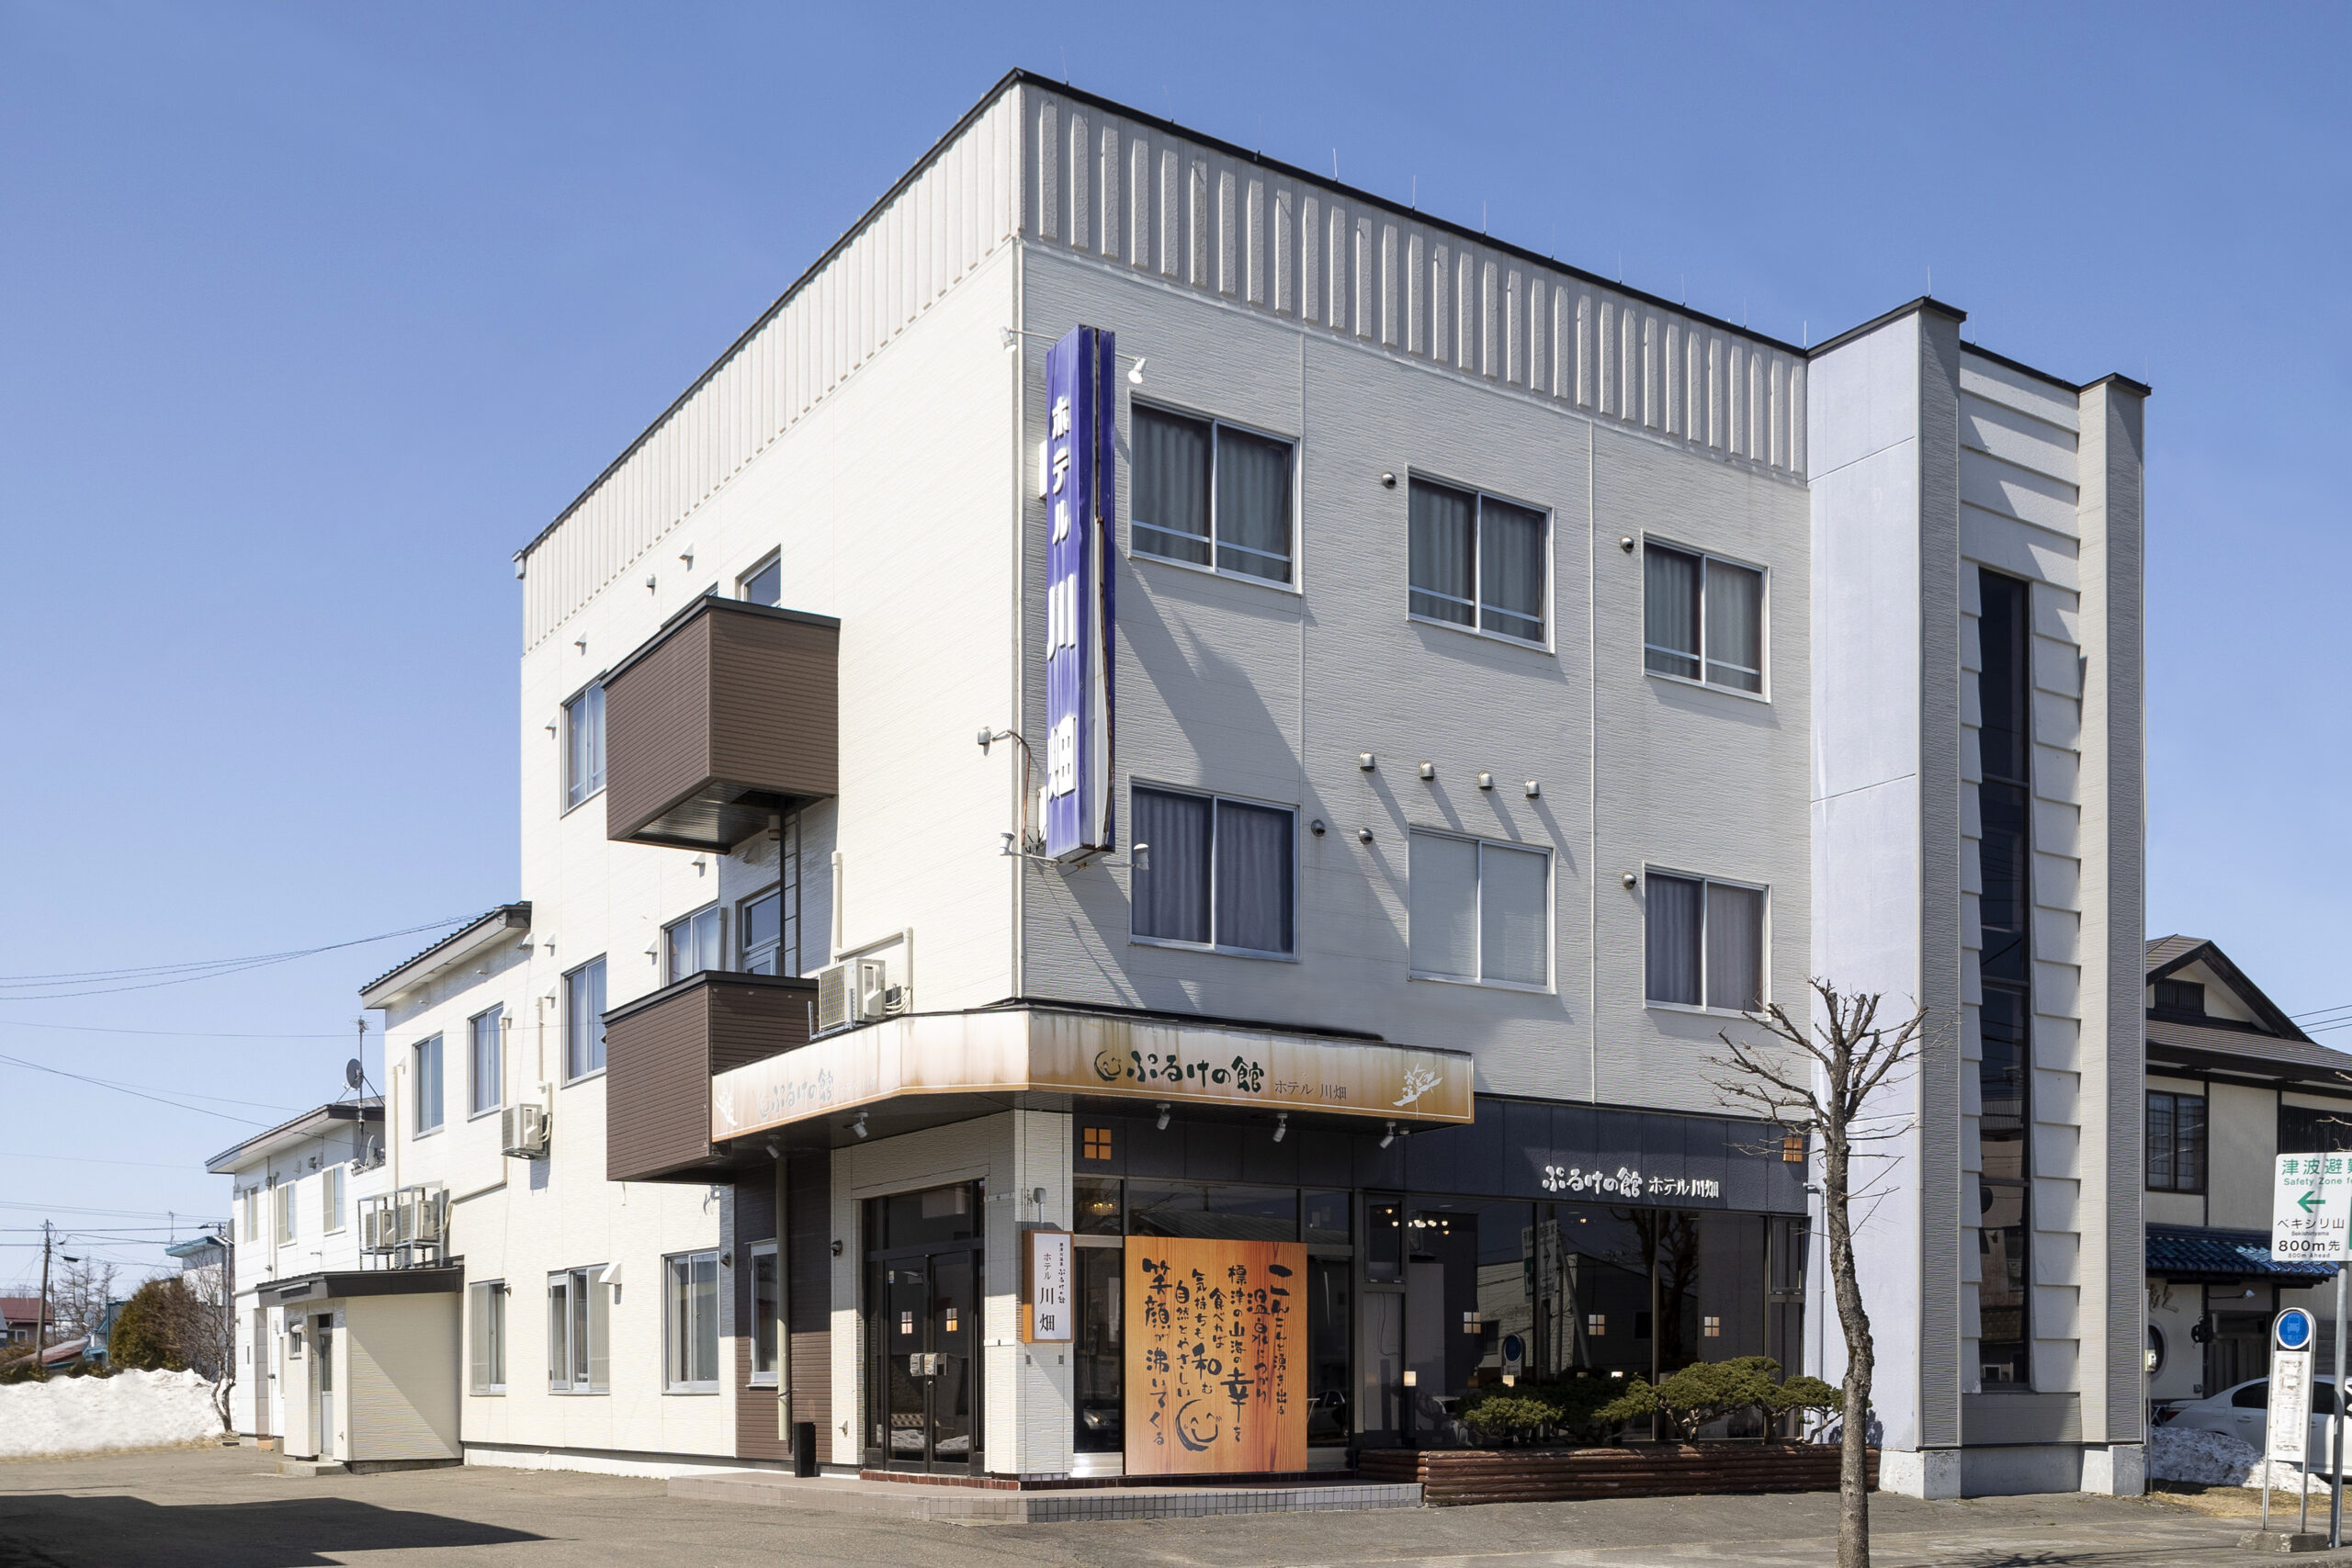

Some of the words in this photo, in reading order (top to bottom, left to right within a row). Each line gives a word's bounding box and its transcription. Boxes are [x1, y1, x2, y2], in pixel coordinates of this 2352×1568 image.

[1275, 1079, 1312, 1095] ホテル
[1320, 1083, 1347, 1100] 川畑
[1542, 1165, 1643, 1198] ぷるけの館
[2283, 1178, 2314, 1187] Safety
[2319, 1177, 2343, 1185] Zone
[2277, 1218, 2345, 1230] ベキシリ山
[1209, 1287, 1227, 1349] 食べれば
[1175, 1280, 1191, 1397] 自然とやさしい
